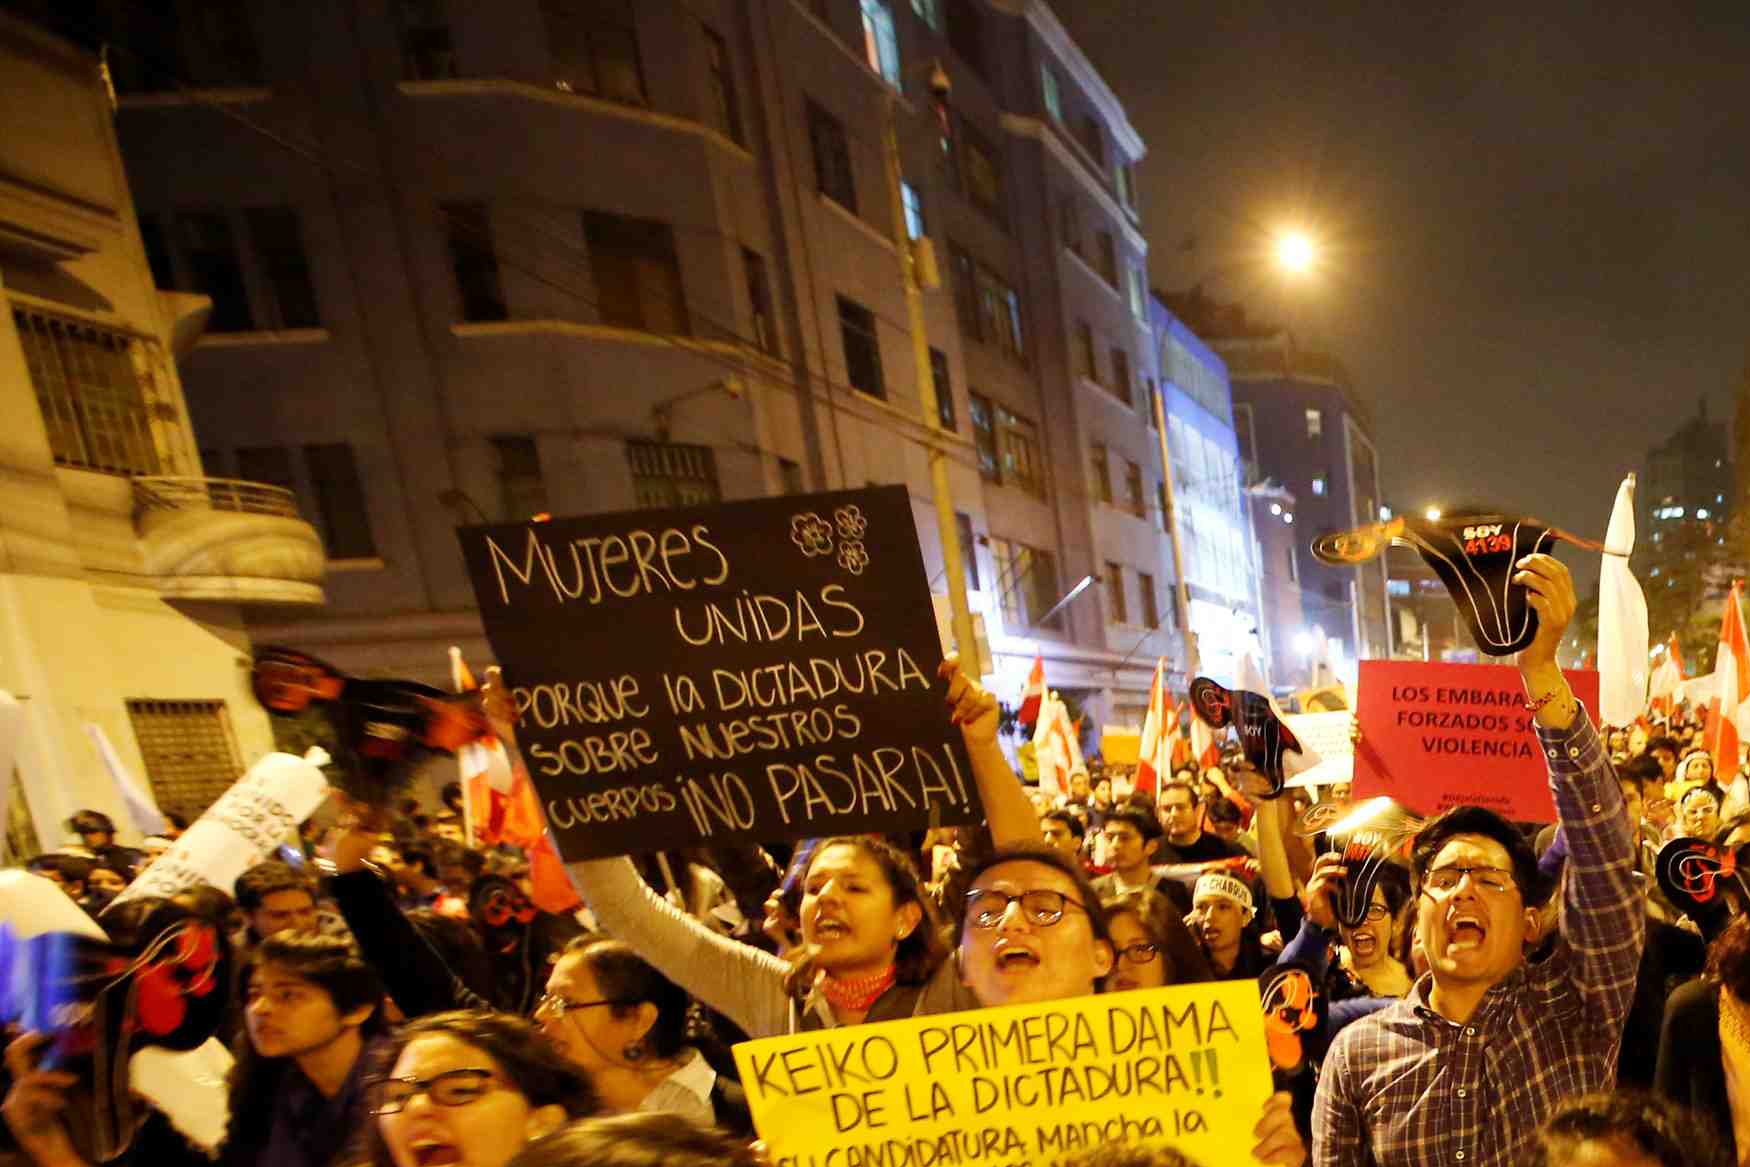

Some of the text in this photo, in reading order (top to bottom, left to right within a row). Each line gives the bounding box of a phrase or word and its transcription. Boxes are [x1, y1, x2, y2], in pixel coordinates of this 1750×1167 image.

[1463, 523, 1503, 540] SOY
[712, 648, 929, 712] DICTADURA
[1392, 686, 1526, 707] LOS EMBARA
[1397, 712, 1509, 732] FORZADOS
[1422, 736, 1533, 759] VIOLENCIA
[768, 743, 970, 825] PASARA!
[750, 1000, 1239, 1100] KEIKO PRIMERA DAMA
[831, 1088, 887, 1133] DE
[907, 1077, 953, 1120] LA
[1173, 1108, 1209, 1136] la
